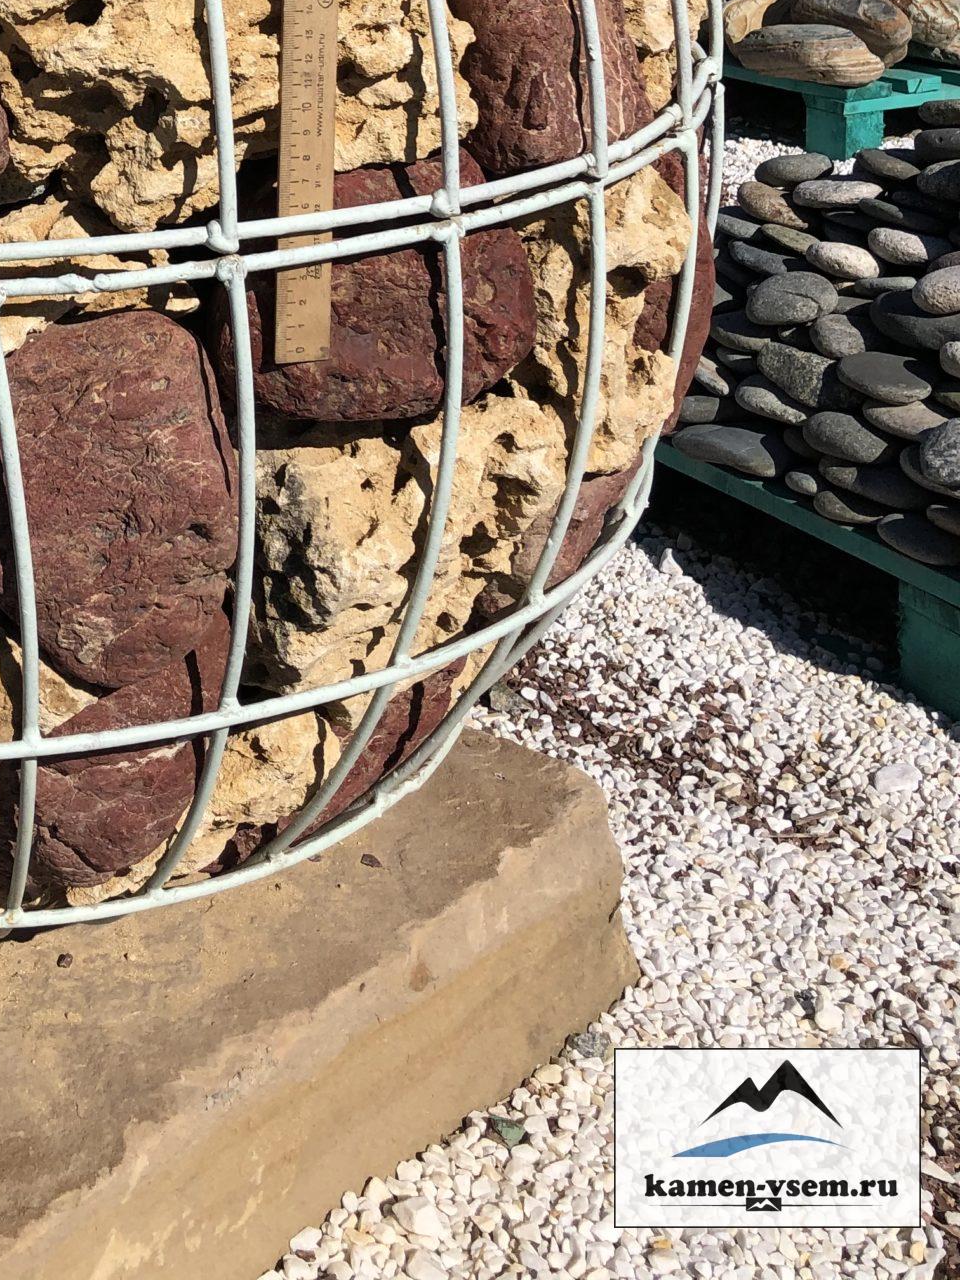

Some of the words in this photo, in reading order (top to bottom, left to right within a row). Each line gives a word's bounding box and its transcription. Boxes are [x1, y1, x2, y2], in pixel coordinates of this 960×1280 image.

[306, 4, 313, 15] 14
[304, 29, 313, 40] 13
[304, 53, 313, 64] 12
[303, 78, 312, 89] 11
[301, 102, 311, 112] 10
